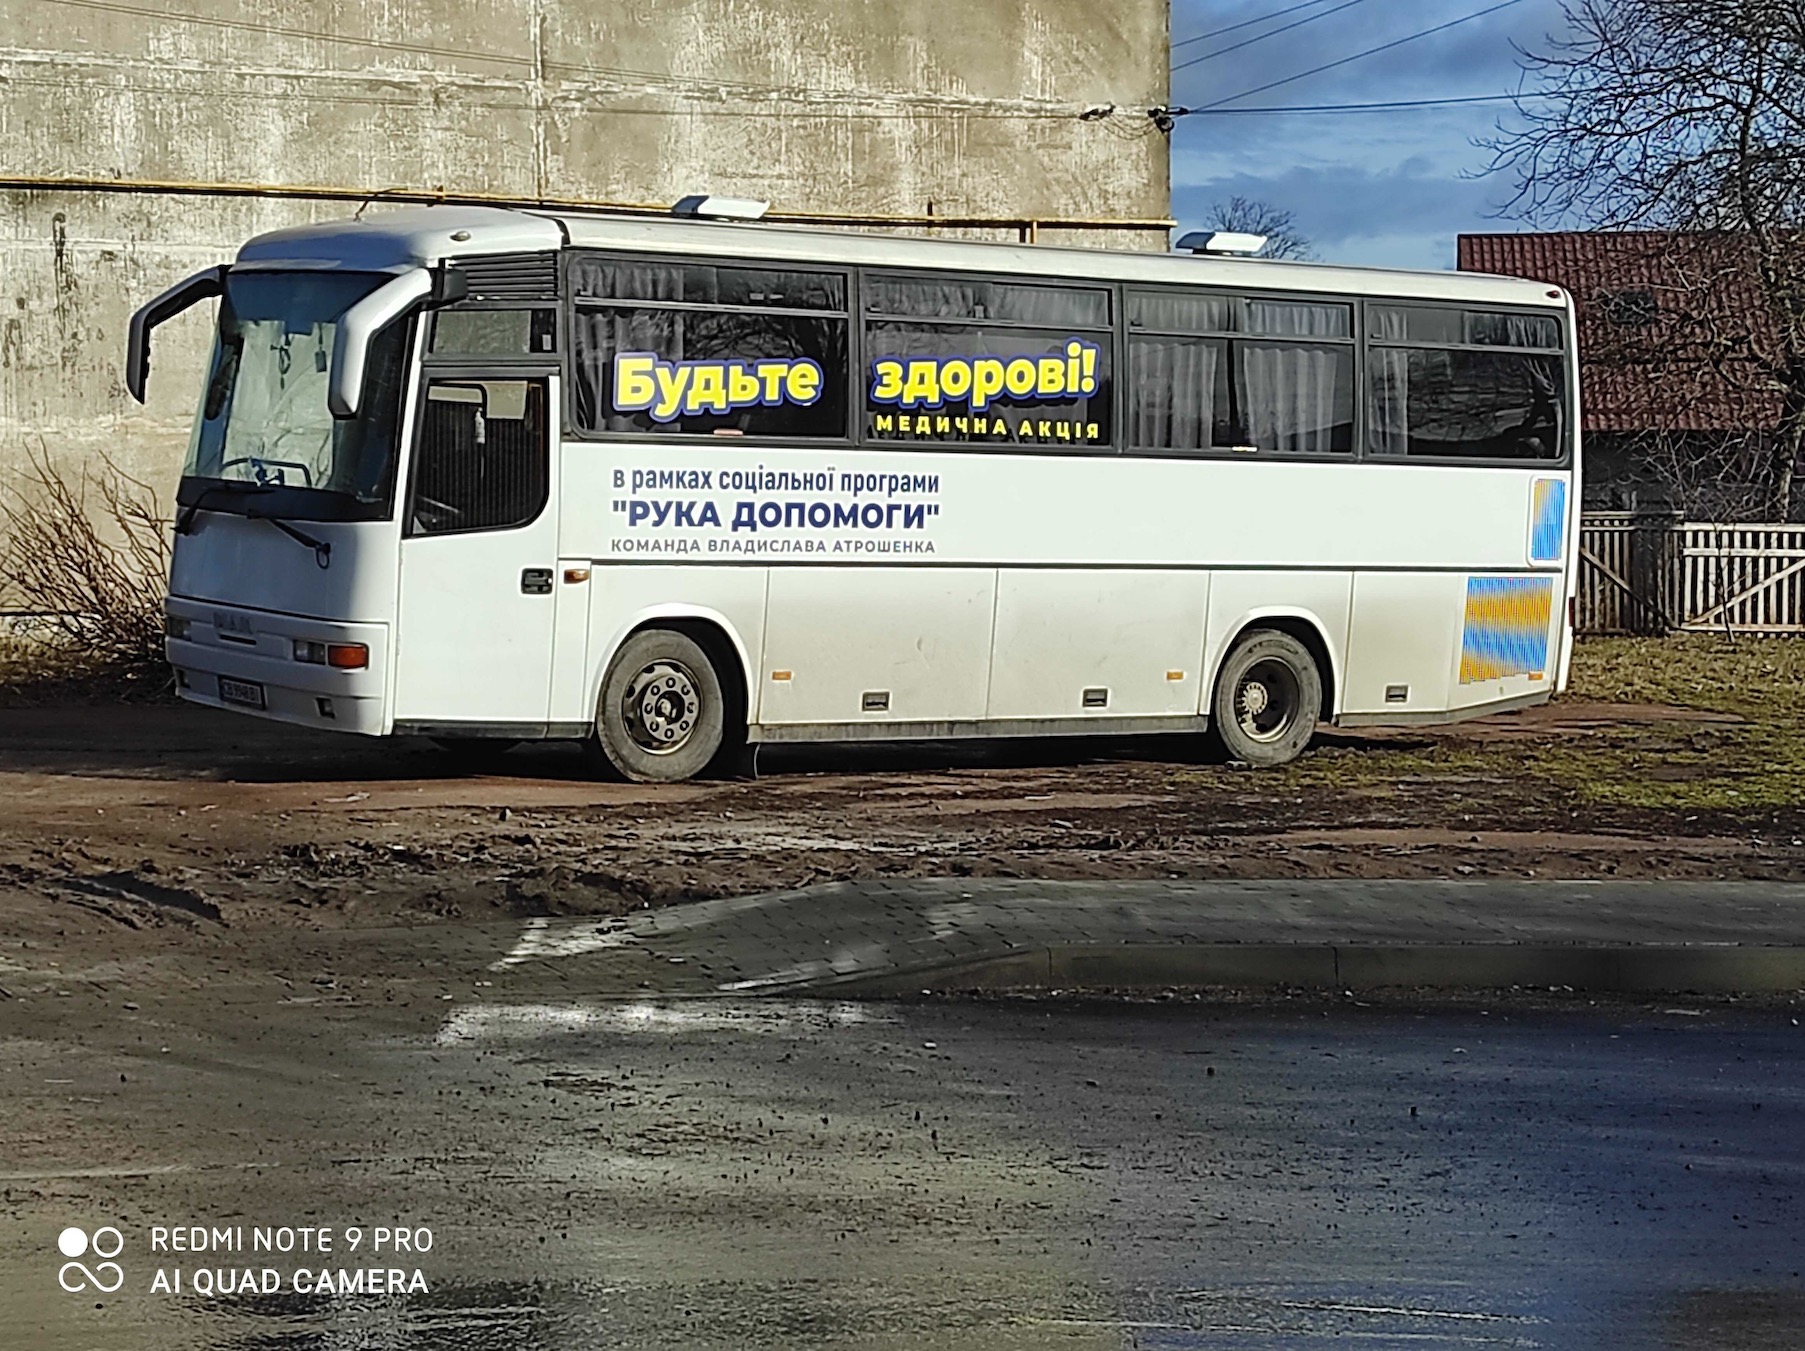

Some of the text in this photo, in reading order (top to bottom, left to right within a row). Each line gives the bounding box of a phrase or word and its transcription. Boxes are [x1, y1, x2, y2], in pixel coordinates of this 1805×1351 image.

[616, 341, 1097, 419] Будьте здорові!
[876, 414, 1099, 440] МЕДИЧНА АКЦІЯ
[612, 464, 939, 498] в рамках соціальної програми
[612, 500, 940, 532] "РУКА ДОПОМОГИ"
[611, 538, 936, 555] КОМАНДА ВЛАДИСЛАВА АТРОШЕНКА
